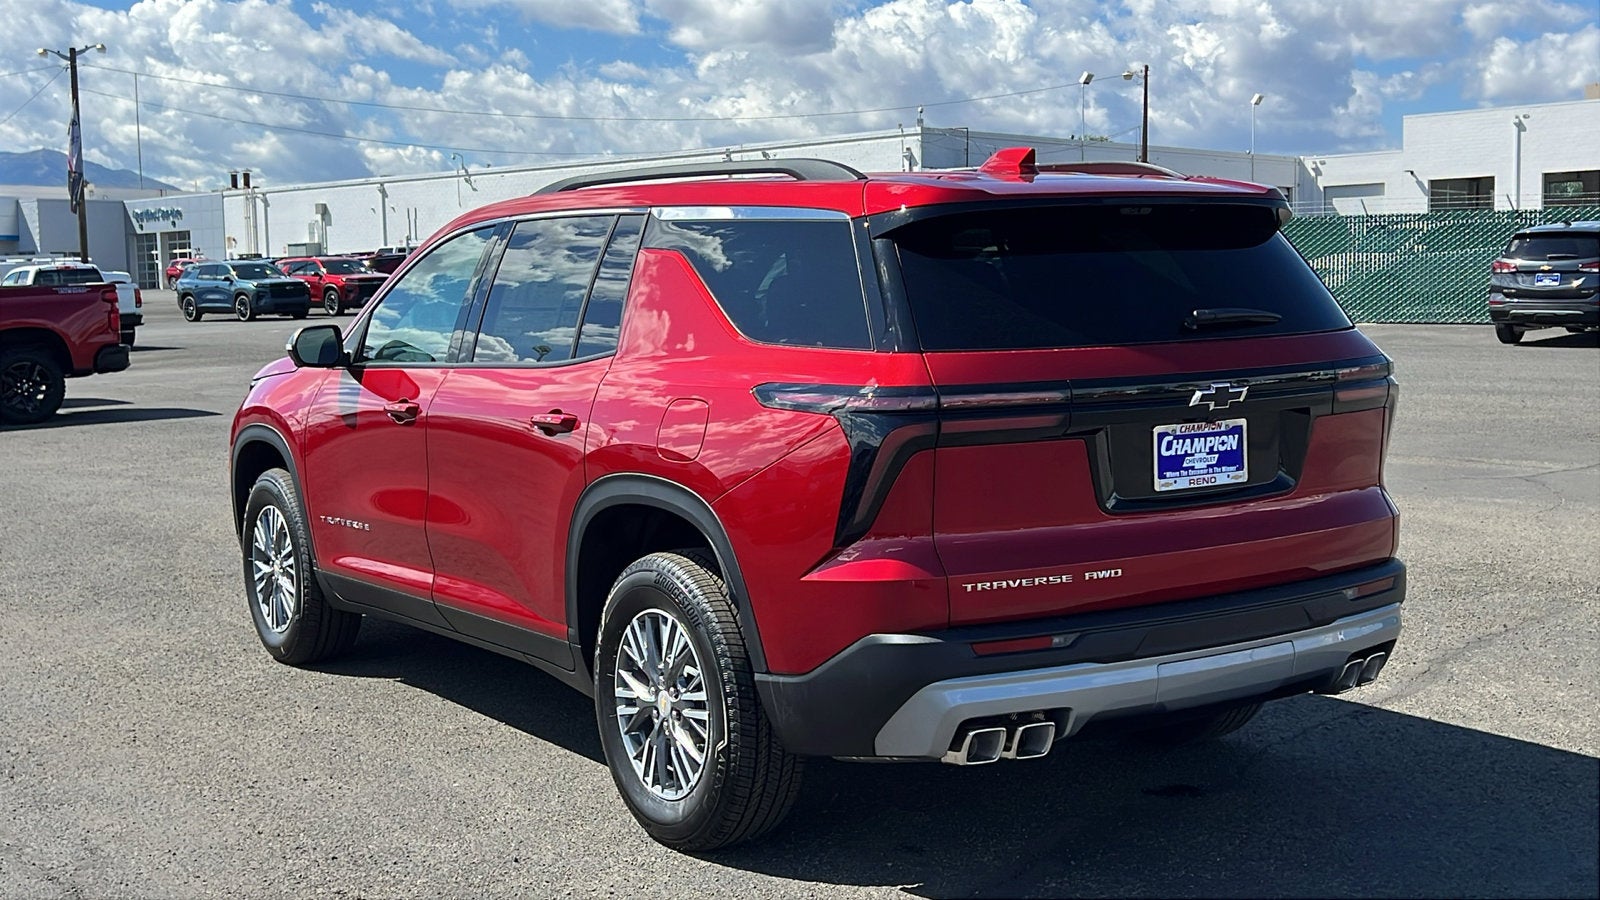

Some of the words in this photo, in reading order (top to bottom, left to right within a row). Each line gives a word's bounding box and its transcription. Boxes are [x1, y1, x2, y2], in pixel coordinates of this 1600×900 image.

[1180, 422, 1222, 433] CHAMPION
[1161, 435, 1239, 456] CHAMPION
[1186, 456, 1216, 465] CHEVROLET
[1189, 476, 1217, 486] RENO
[320, 515, 370, 531] TRAVERSE
[962, 574, 1073, 592] TRAVERSE
[1084, 568, 1122, 581] AWD
[654, 573, 704, 629] BRIDGESTONE
